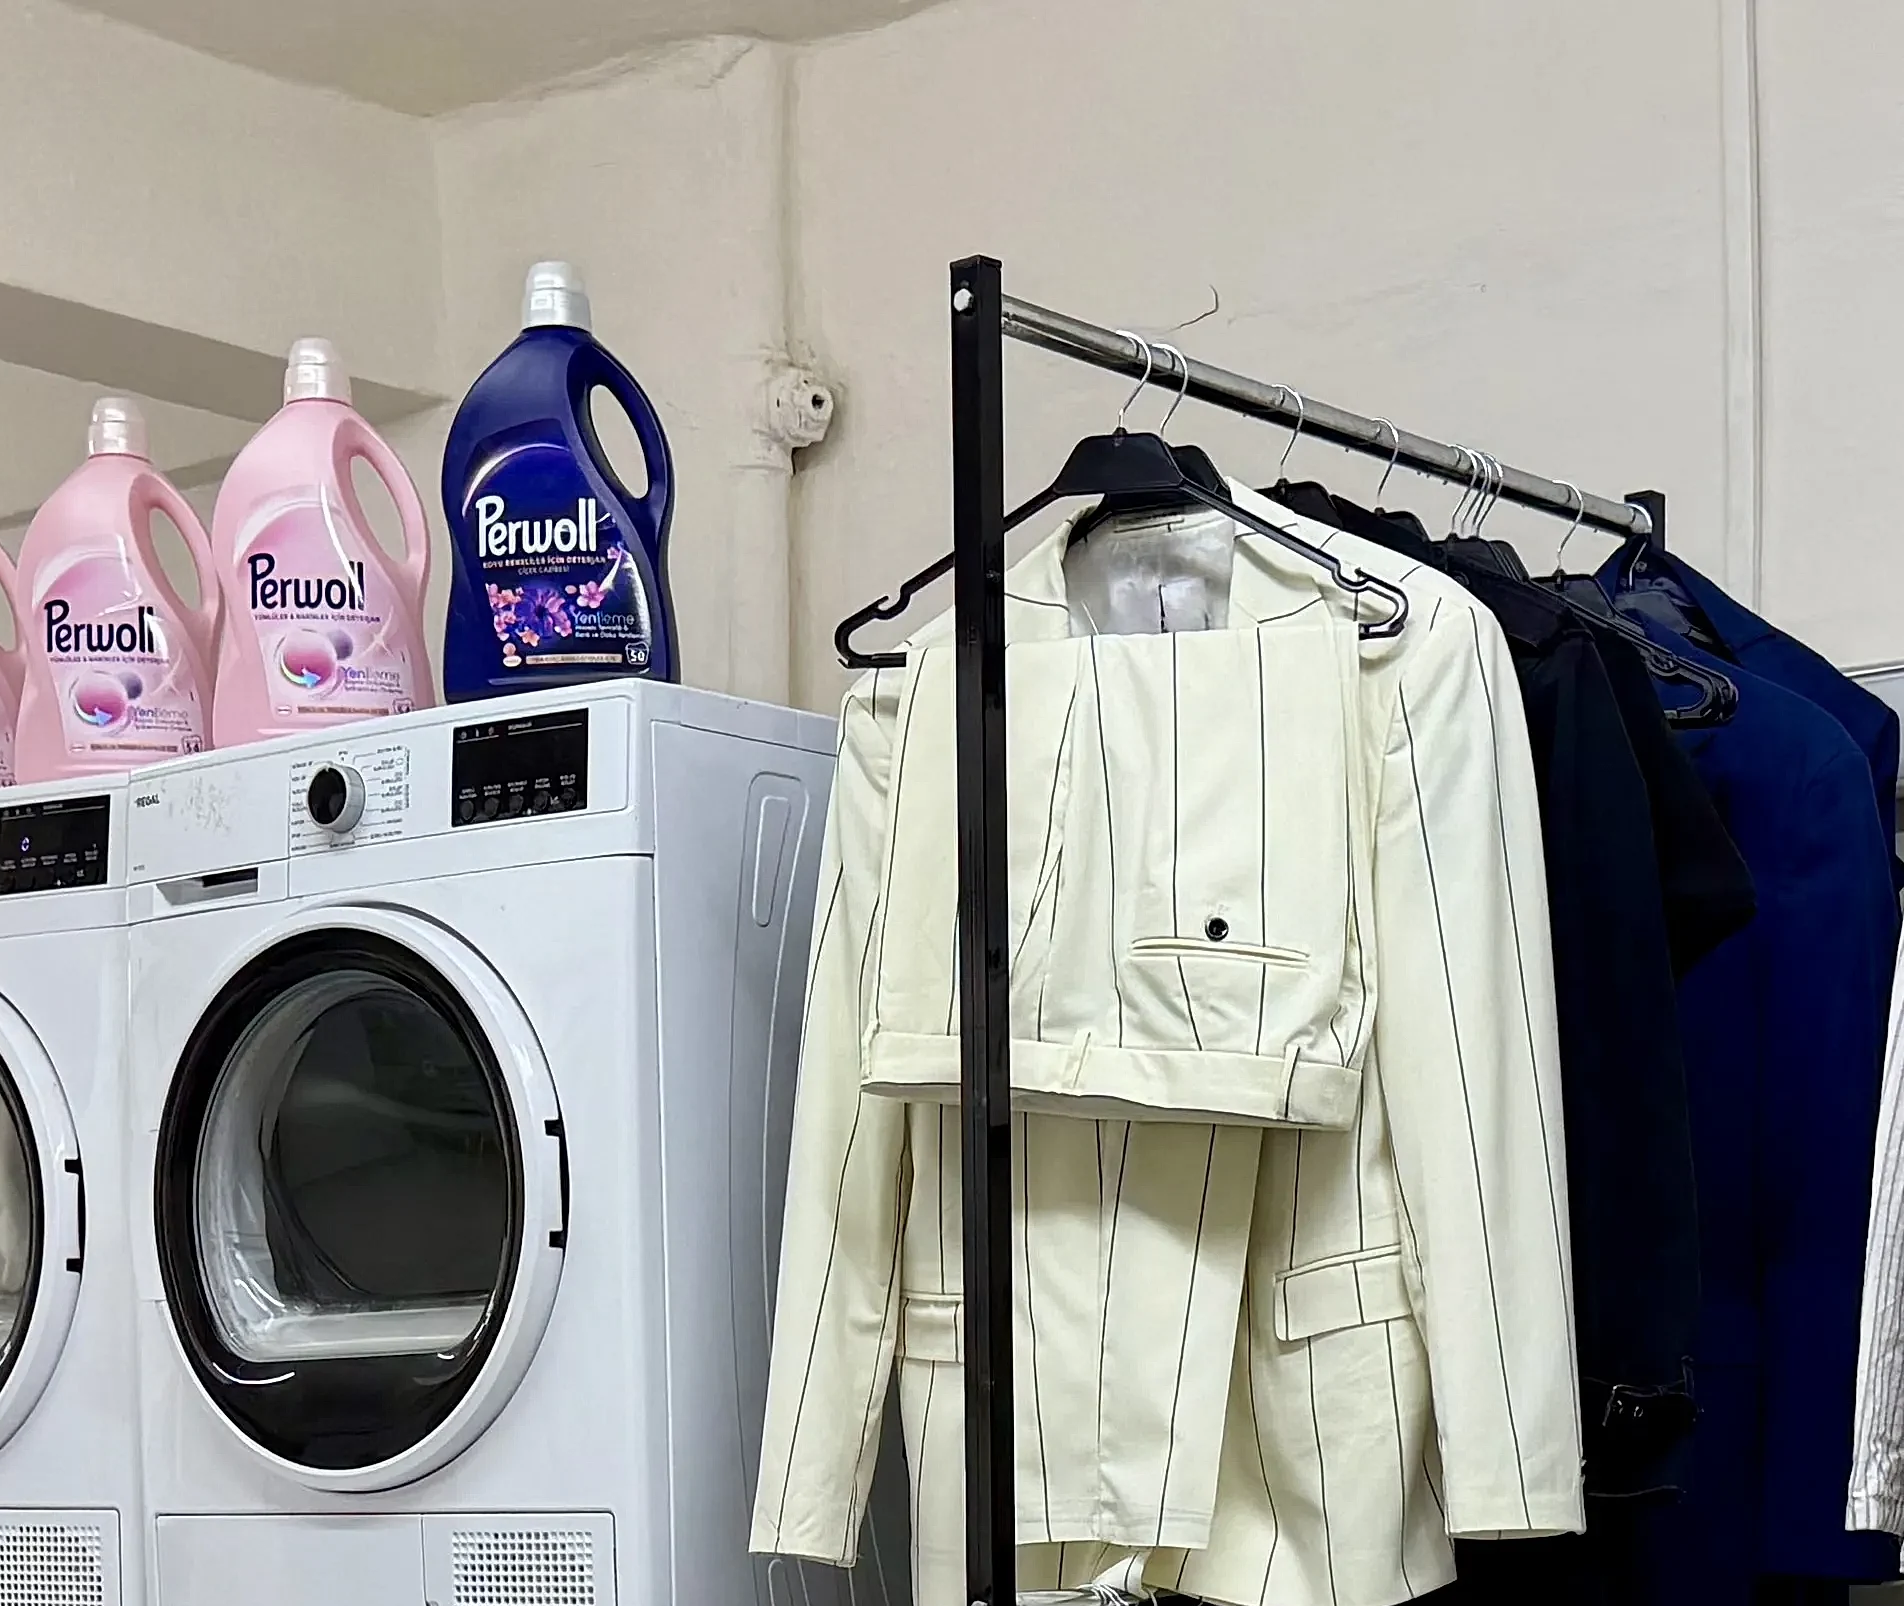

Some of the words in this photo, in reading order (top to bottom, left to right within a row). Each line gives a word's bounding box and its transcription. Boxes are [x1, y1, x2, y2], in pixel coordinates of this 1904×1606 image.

[475, 495, 597, 558] Perwoll
[247, 553, 365, 611] Perwoll
[43, 599, 154, 653] Perwoll
[630, 649, 645, 662] 50
